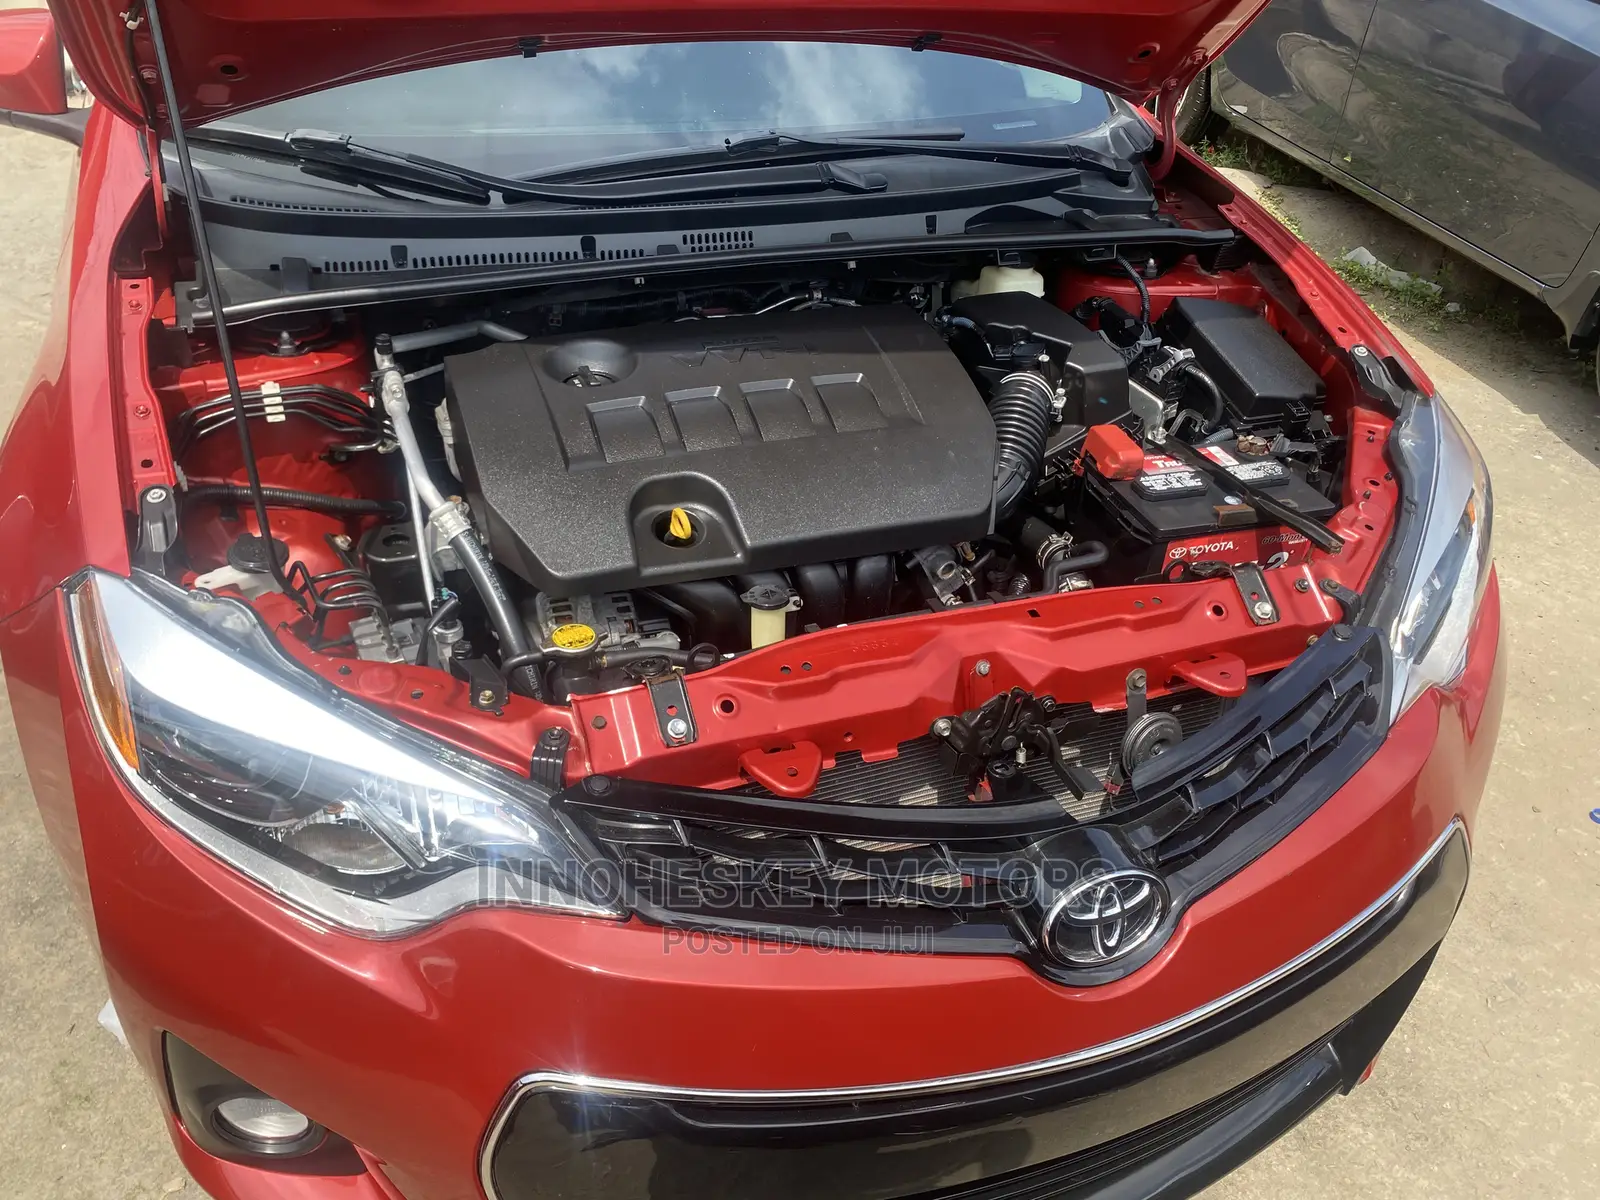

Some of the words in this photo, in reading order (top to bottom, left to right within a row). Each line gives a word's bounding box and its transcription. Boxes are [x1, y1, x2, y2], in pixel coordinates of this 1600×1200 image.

[1152, 459, 1183, 469] TRU
[1189, 541, 1234, 556] TOYOTA
[525, 665, 538, 690] ICHIRIN
